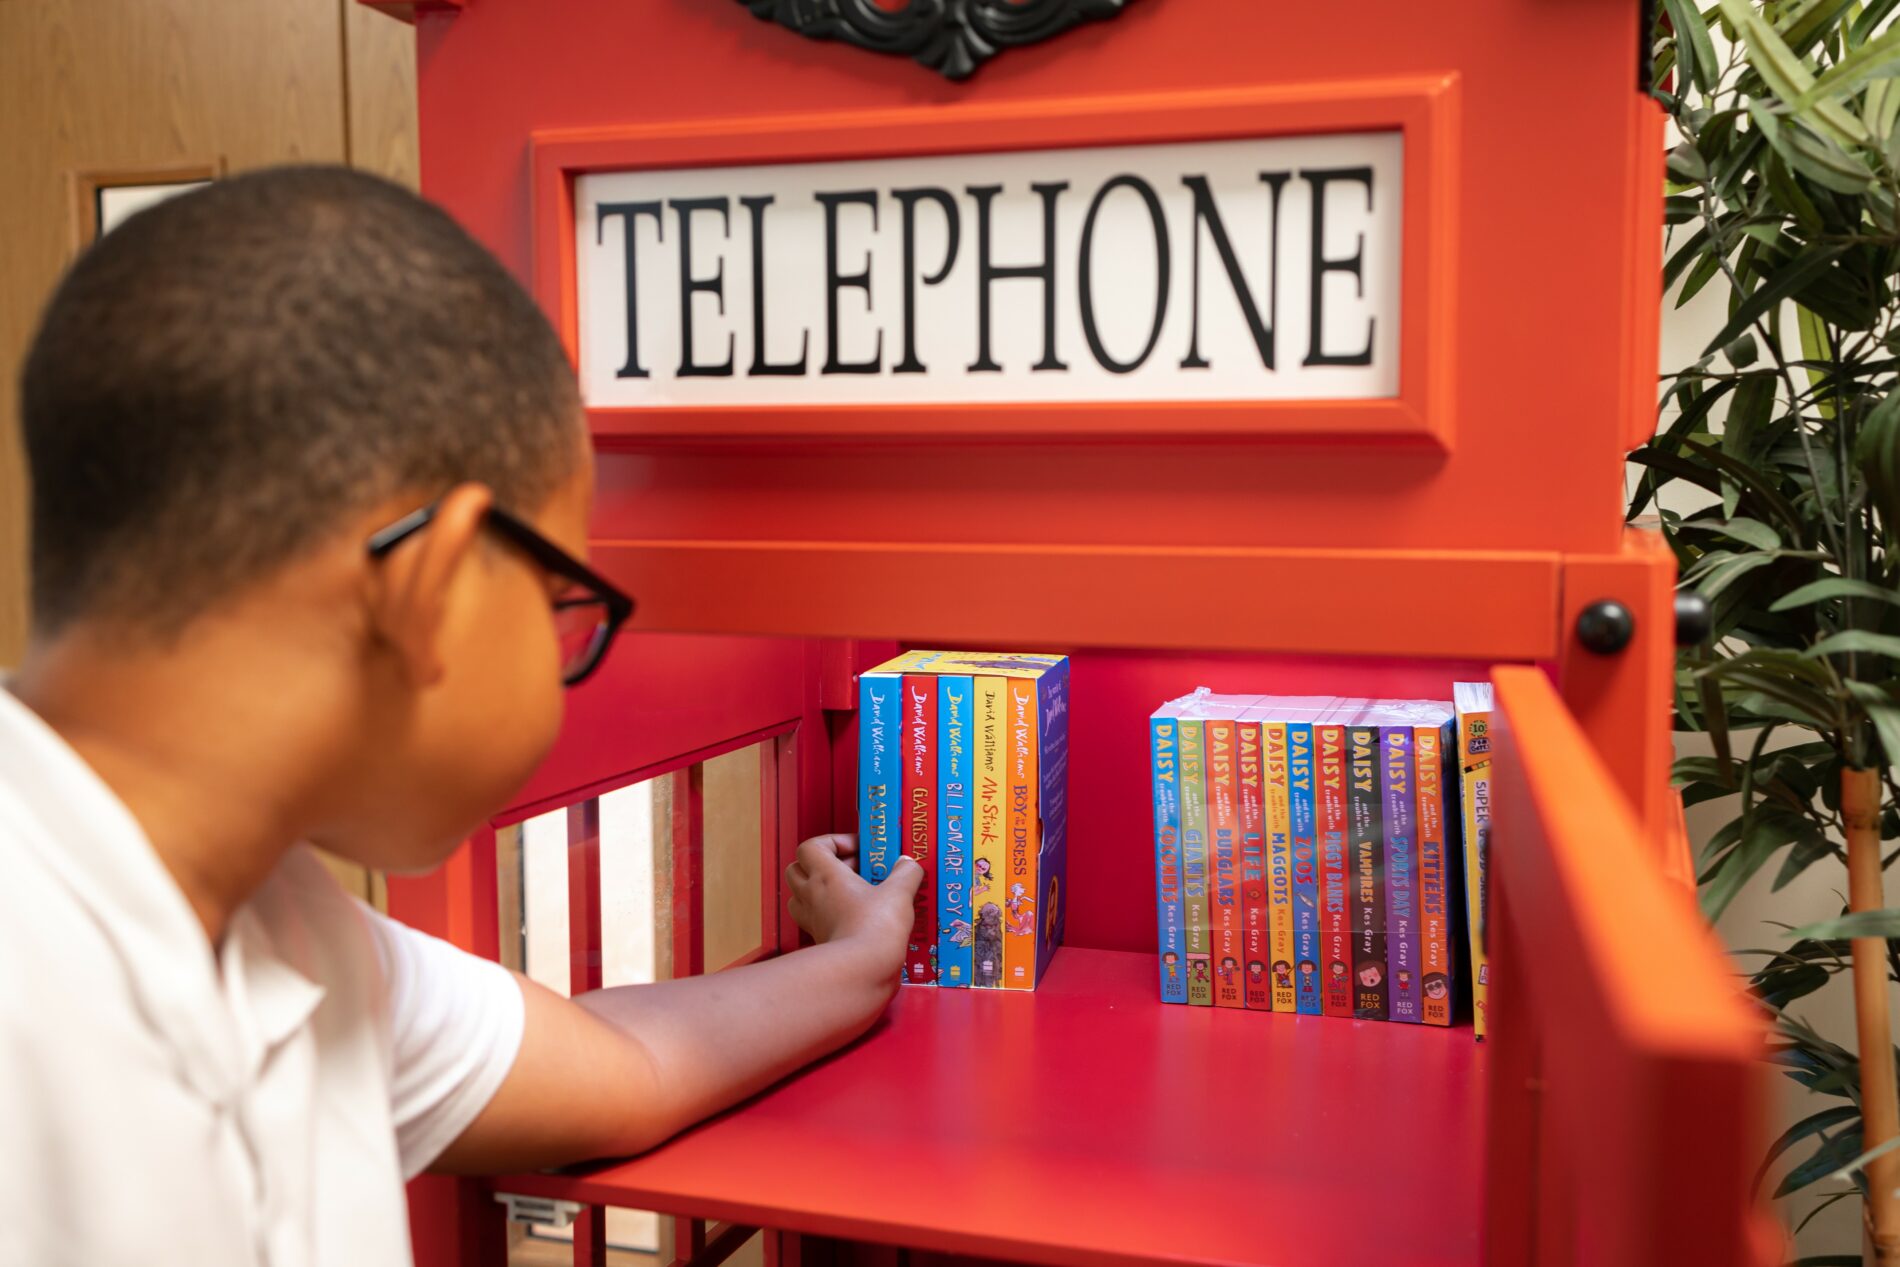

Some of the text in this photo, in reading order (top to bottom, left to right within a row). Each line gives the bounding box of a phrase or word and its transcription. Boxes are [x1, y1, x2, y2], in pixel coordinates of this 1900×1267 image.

[596, 166, 1377, 379] TELEPHONE
[870, 687, 885, 775] David Walliams
[912, 686, 927, 776] David Walliams
[947, 687, 963, 778] David Walliams
[984, 690, 996, 772] David Walliams
[1014, 688, 1030, 778] David Walliams
[1156, 724, 1174, 783] DAISY
[1182, 726, 1199, 784] DAISY
[1212, 728, 1230, 786] DAISY
[1240, 728, 1257, 788] DAISY
[1267, 728, 1284, 787] DAISY
[1472, 724, 1484, 732] 10
[1292, 732, 1309, 791] DAISY
[1322, 730, 1340, 790] DAISY
[1352, 732, 1372, 792] DAISY
[1388, 734, 1406, 794] DAISY
[1418, 736, 1436, 796] DAISY
[912, 788, 928, 862] GANGSTA
[981, 776, 998, 846] Mr Stink
[1013, 785, 1028, 817] BOY
[945, 783, 964, 916] BILLIONAIRE BOY
[1014, 828, 1026, 876] DRESS
[1160, 826, 1178, 903] COCONUTS
[1184, 829, 1204, 897] GIANTS
[1216, 829, 1234, 906] BURGLARS
[1244, 832, 1260, 880] LIFE
[1272, 832, 1288, 905] MAGGOTS
[1295, 836, 1313, 884] ZOOS
[1325, 832, 1344, 912] PIGGY BANKS
[1359, 842, 1374, 903] VAMPIRES
[1391, 837, 1410, 918] SPORTS DAY
[1424, 842, 1440, 915] KITTENS
[1168, 905, 1176, 950] Kes Gray
[1192, 904, 1200, 948] Kes Gray
[1223, 908, 1232, 954] Kes Gray
[1250, 908, 1260, 952] Kes Gray
[1276, 908, 1286, 954] Kes Gray
[1302, 912, 1310, 958] Kes Gray
[1332, 914, 1342, 960] Kes Gray
[1363, 908, 1373, 954] Kes Gray
[1398, 920, 1408, 967] Kes Gray
[1430, 920, 1438, 967] Kes Gray
